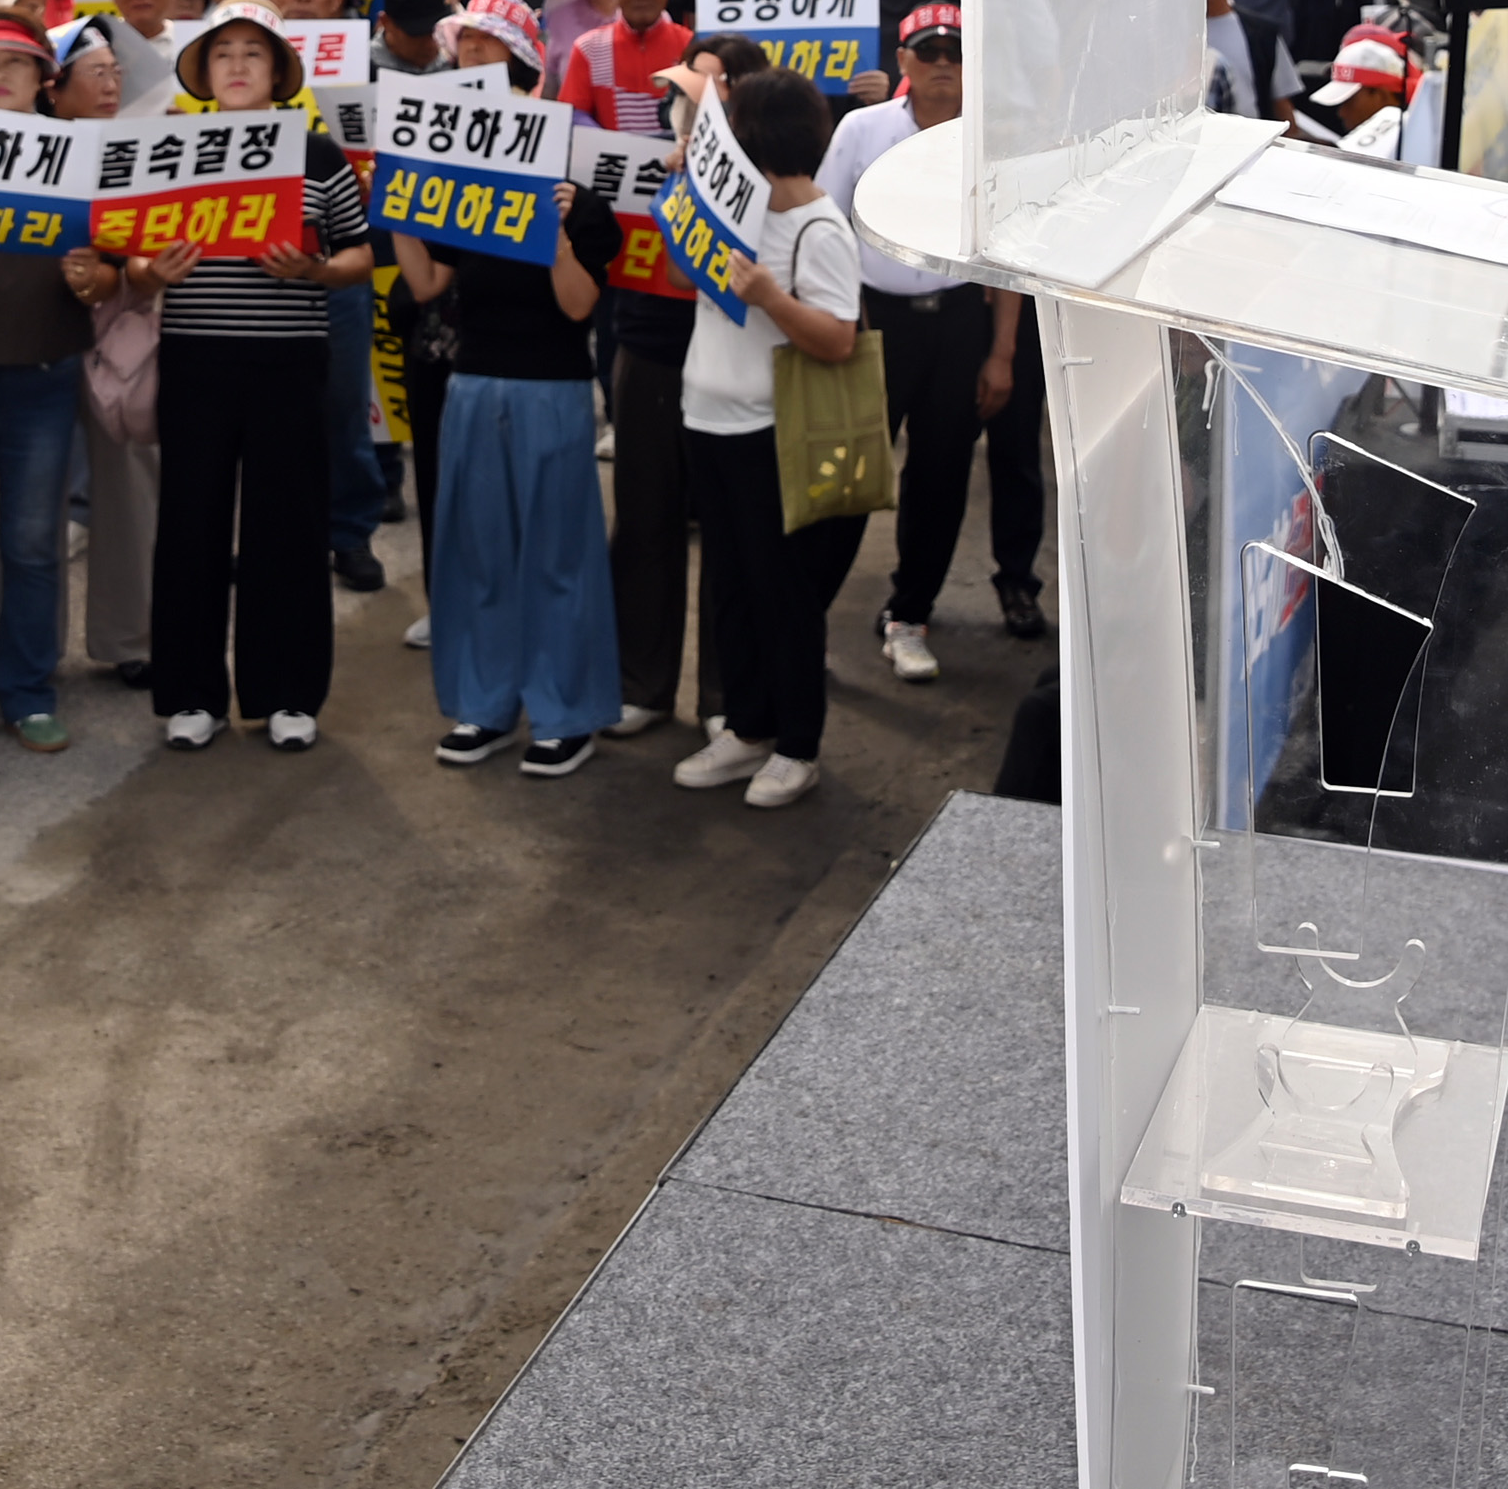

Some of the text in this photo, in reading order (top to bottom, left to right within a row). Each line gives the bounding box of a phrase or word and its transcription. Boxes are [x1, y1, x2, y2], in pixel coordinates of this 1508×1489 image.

[904, 4, 961, 33] 공정심
[98, 122, 280, 191] 졸속결정
[392, 97, 548, 164] 공정하게
[92, 192, 277, 253] 중단하라
[381, 169, 537, 243] 심의하라
